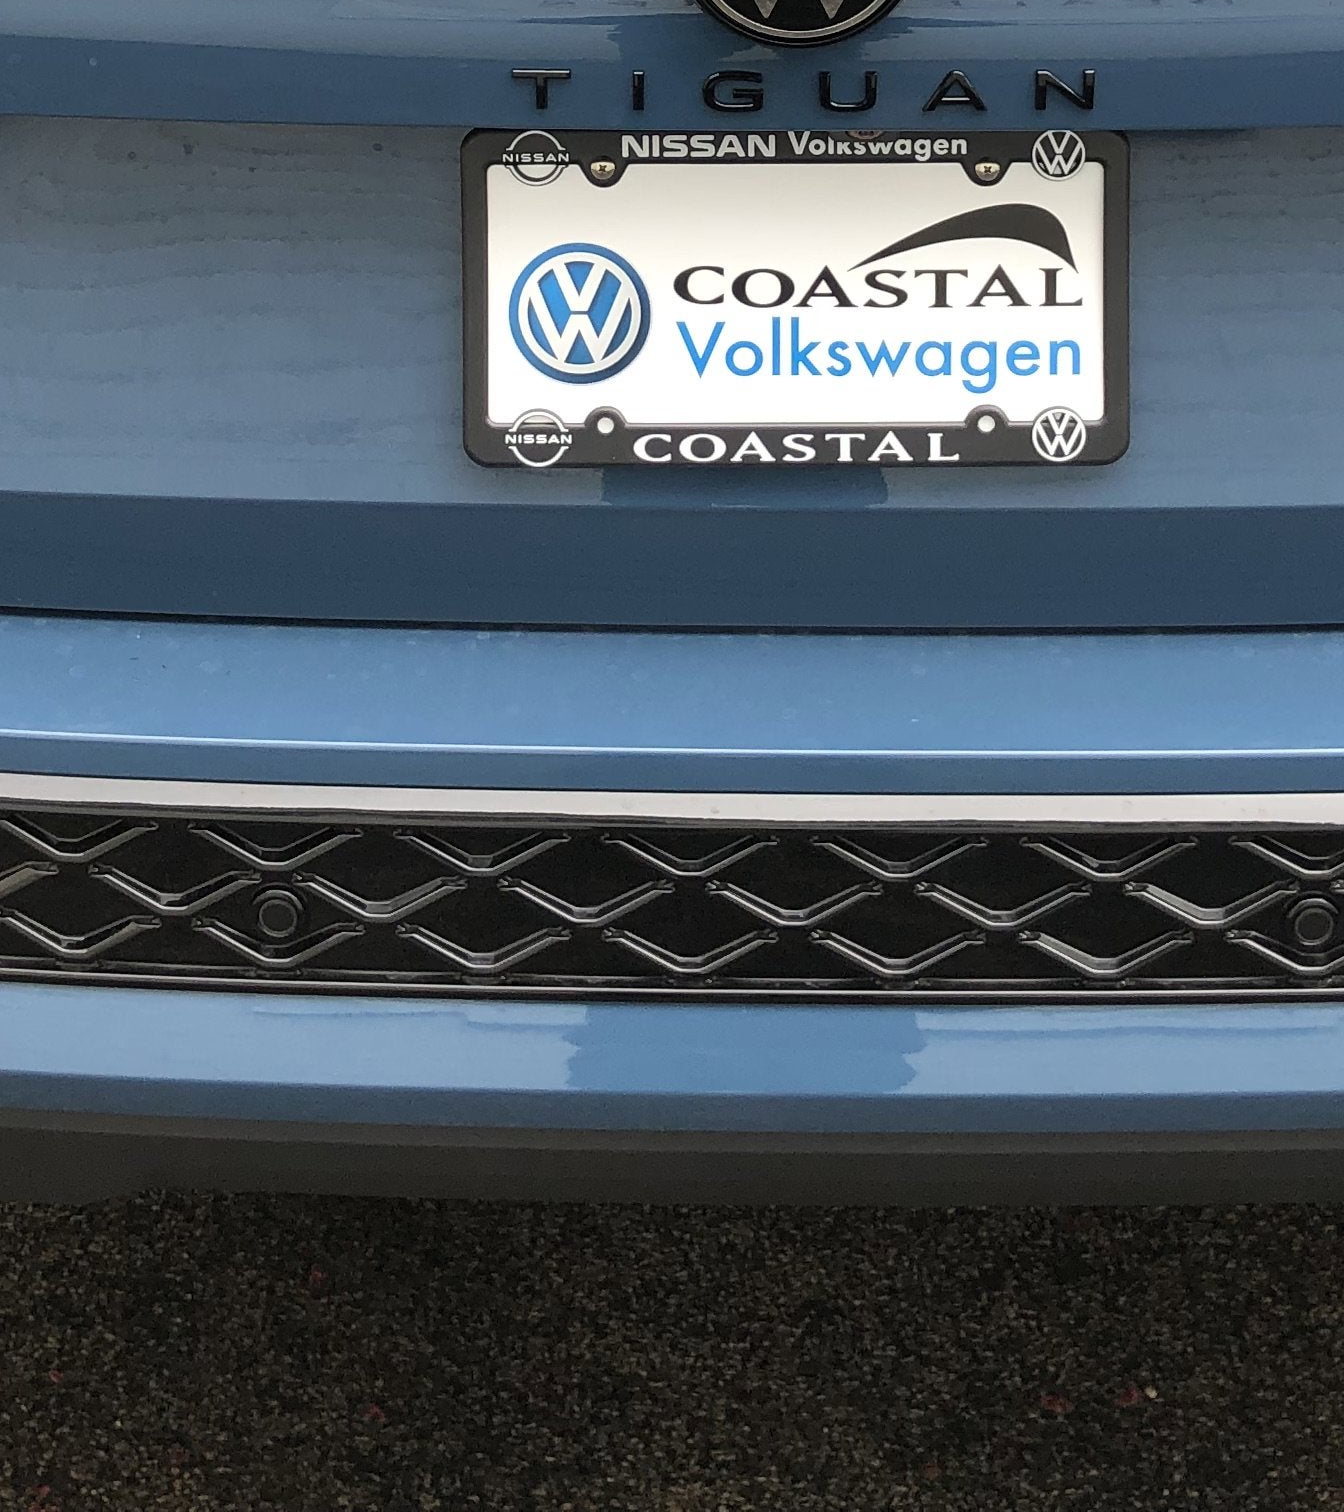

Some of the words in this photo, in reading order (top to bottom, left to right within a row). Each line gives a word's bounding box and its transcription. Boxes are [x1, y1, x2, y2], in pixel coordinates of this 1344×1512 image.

[512, 67, 1095, 112] TIGUAN
[502, 152, 570, 163] NISSAN
[621, 133, 776, 158] NISSAN
[787, 131, 968, 162] Volkswagen
[672, 265, 1083, 309] COASTAL
[676, 317, 1081, 394] Volkswagen
[504, 432, 573, 446] NISSAN
[632, 431, 960, 464] COASTAL
